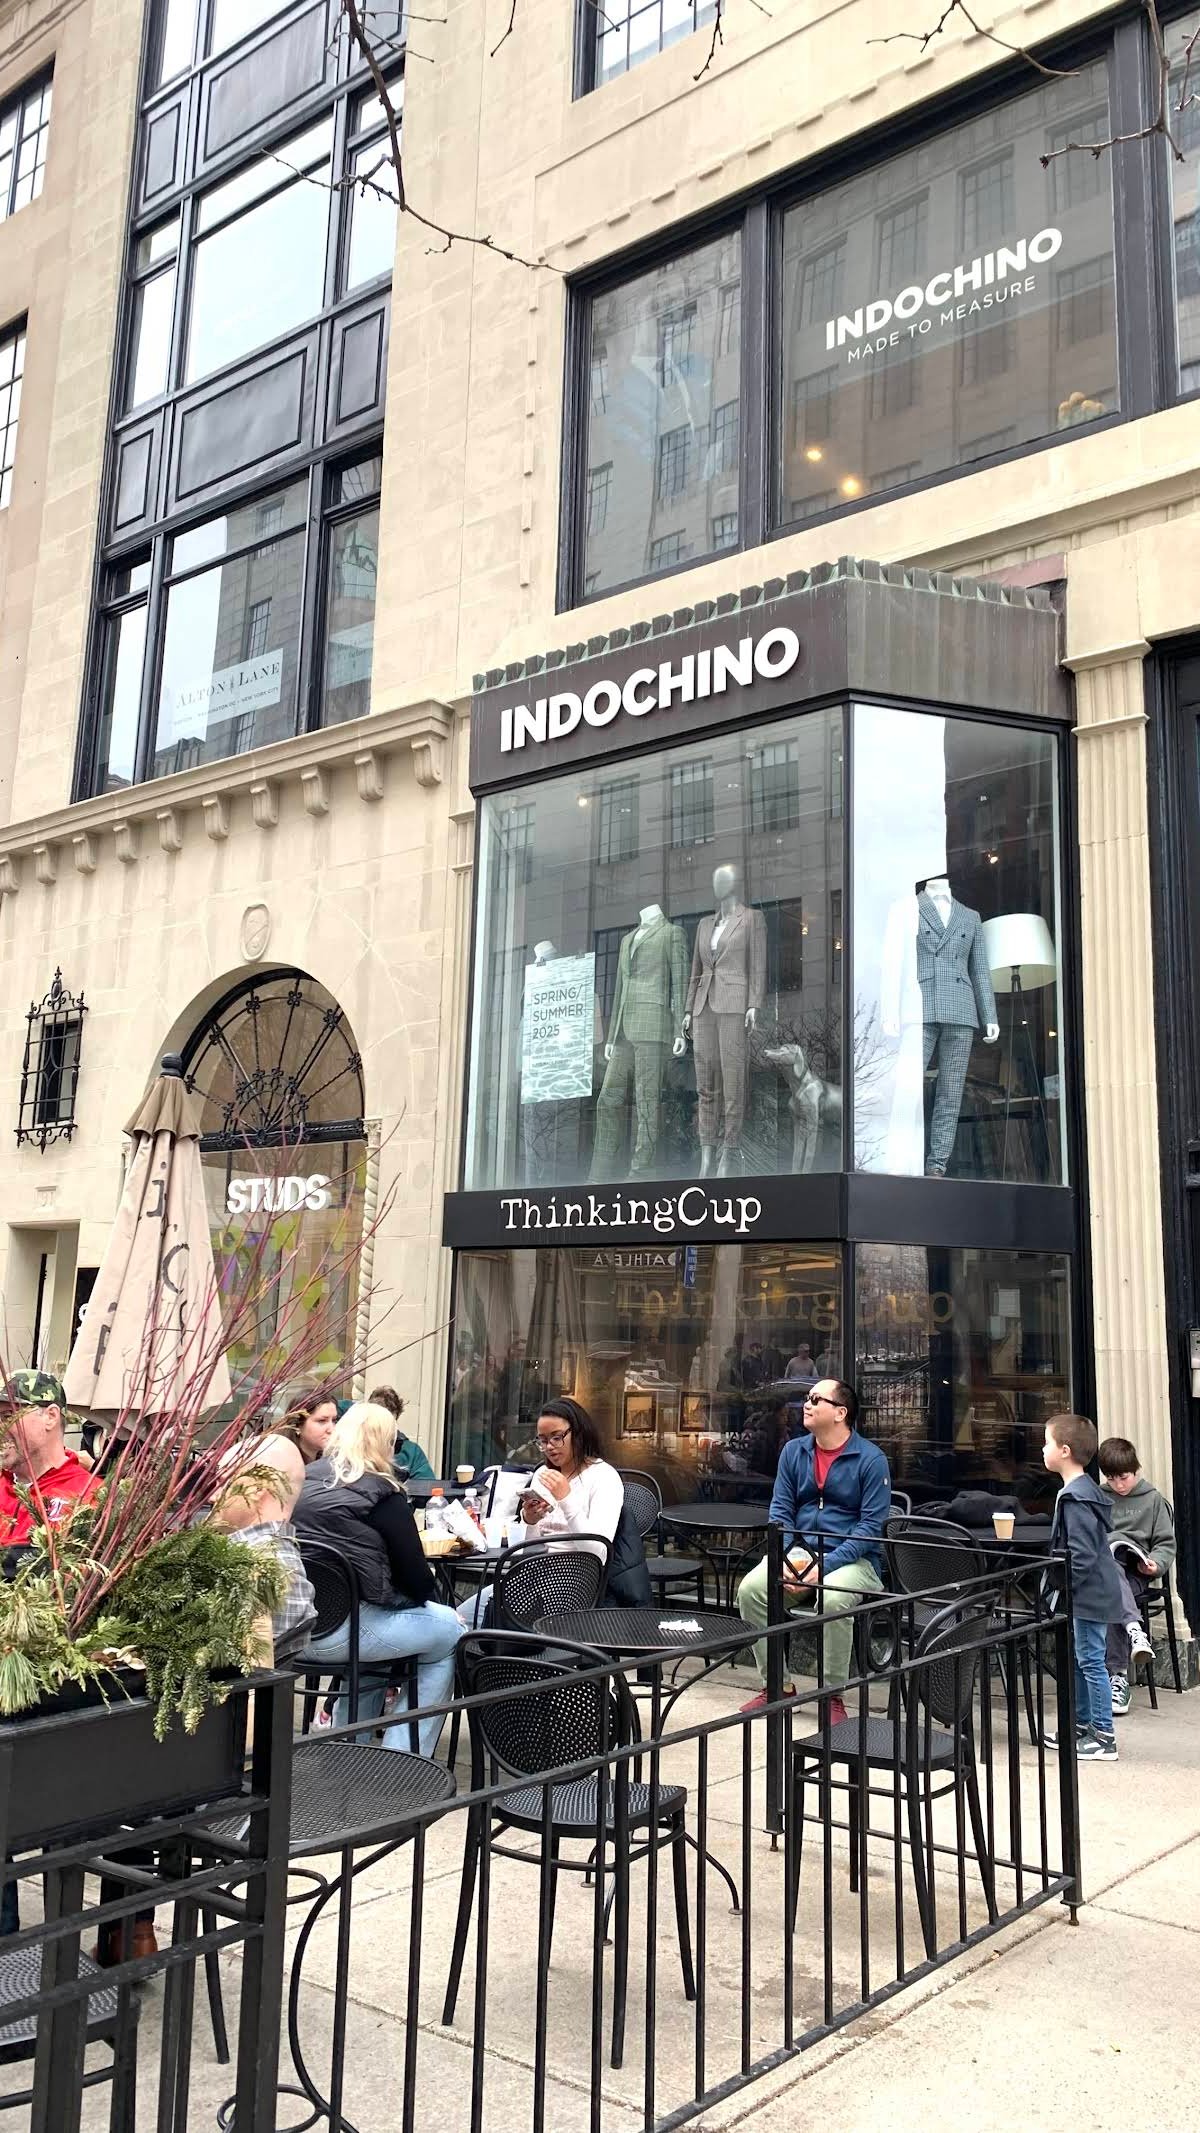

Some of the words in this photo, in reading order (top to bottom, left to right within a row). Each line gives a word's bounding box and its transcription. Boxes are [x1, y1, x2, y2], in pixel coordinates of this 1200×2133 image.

[825, 227, 1063, 350] INDOCHINO
[847, 334, 900, 364] MADE
[907, 318, 933, 339] TO
[940, 275, 1037, 327] MEASURE
[238, 661, 280, 687] LANE
[499, 626, 801, 753] INDOCHINO
[533, 984, 583, 1005] SPRING/
[533, 1003, 583, 1021] SUMMER
[532, 1024, 561, 1040] 2025
[226, 1173, 331, 1214] STUDS
